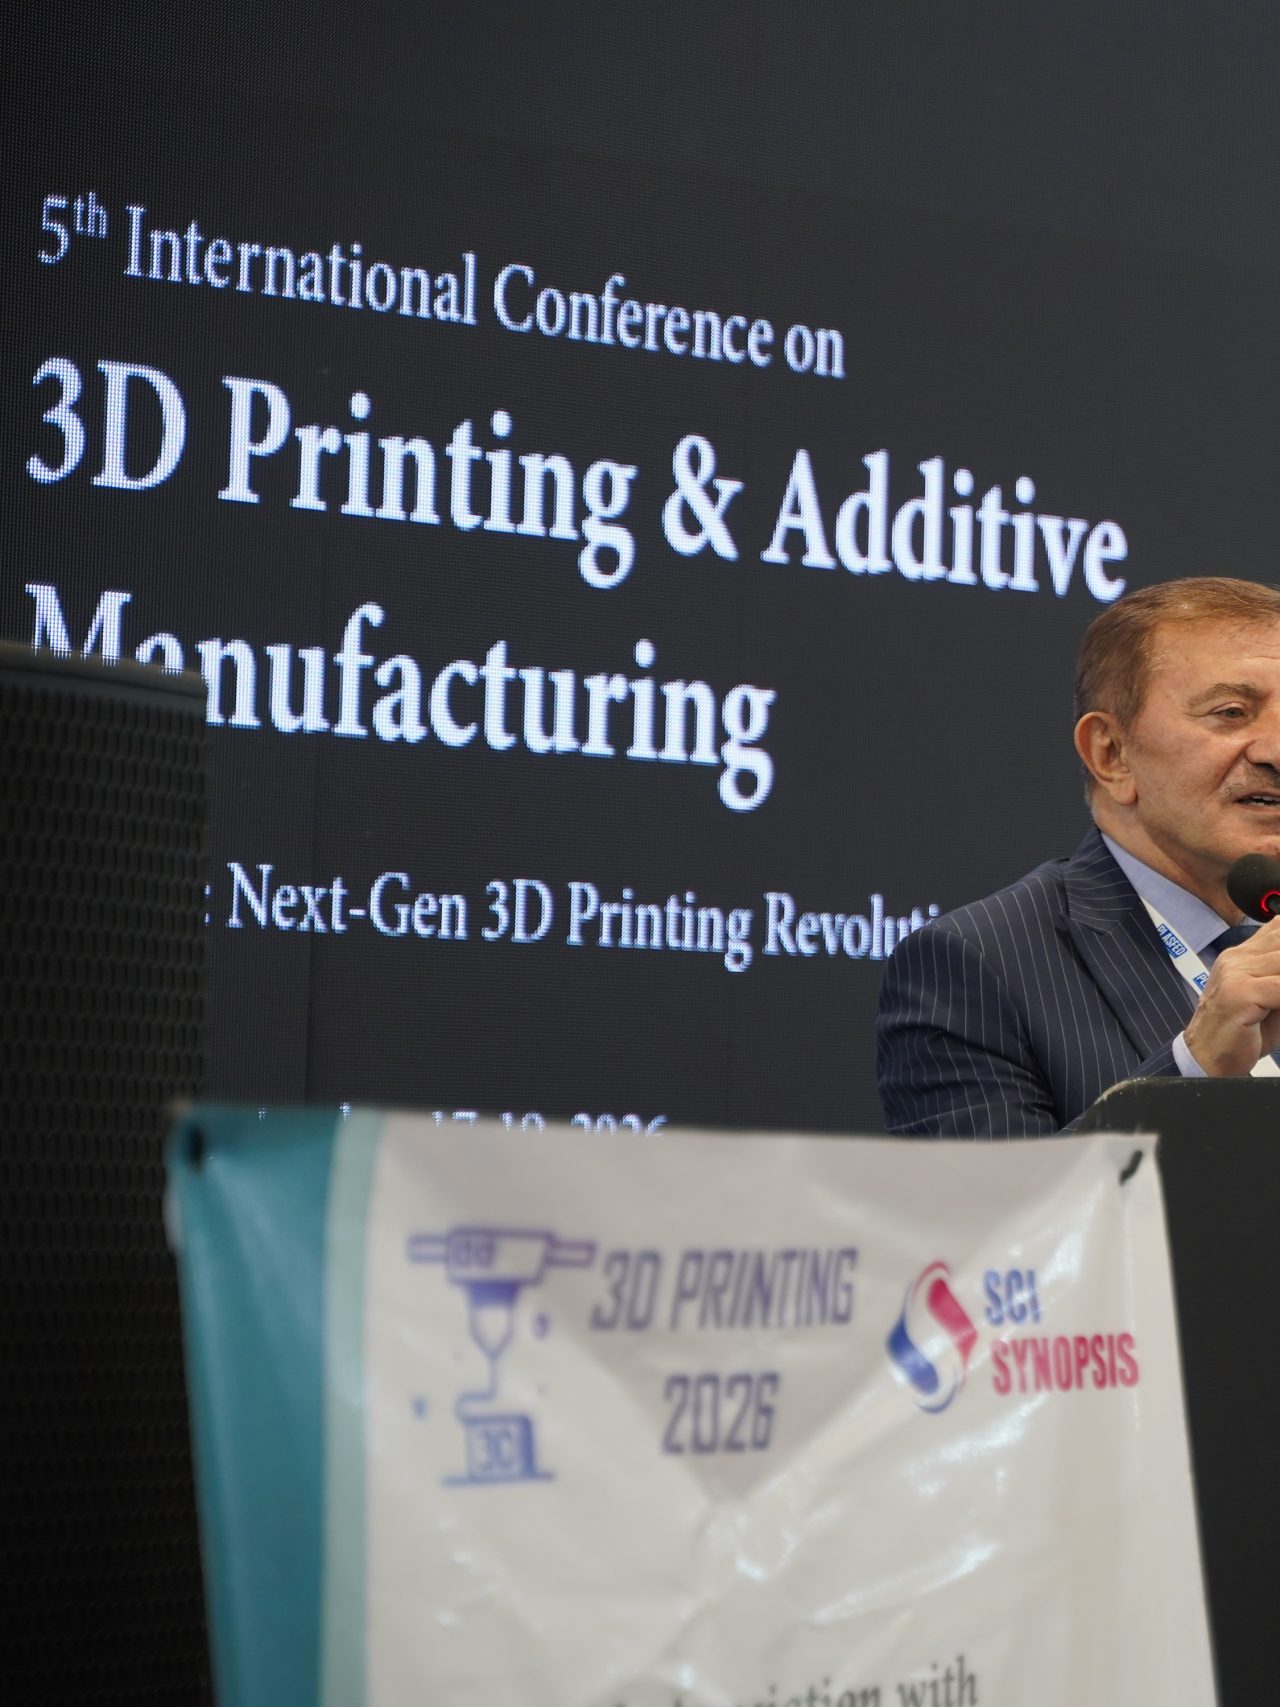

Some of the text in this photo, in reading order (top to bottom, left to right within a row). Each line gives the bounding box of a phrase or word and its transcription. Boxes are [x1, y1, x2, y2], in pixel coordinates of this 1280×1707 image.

[37, 191, 845, 378] 5th International Conference on
[26, 357, 1128, 603] 3D Printing & Additive
[227, 862, 467, 940] Next-Gen
[482, 878, 553, 943] 3D
[567, 881, 753, 973] Printing
[589, 1248, 859, 1332] 3D PRINTING
[983, 1268, 1041, 1326] SCI
[992, 1332, 1140, 1396] SYNOPSIS
[660, 1372, 780, 1455] 2026
